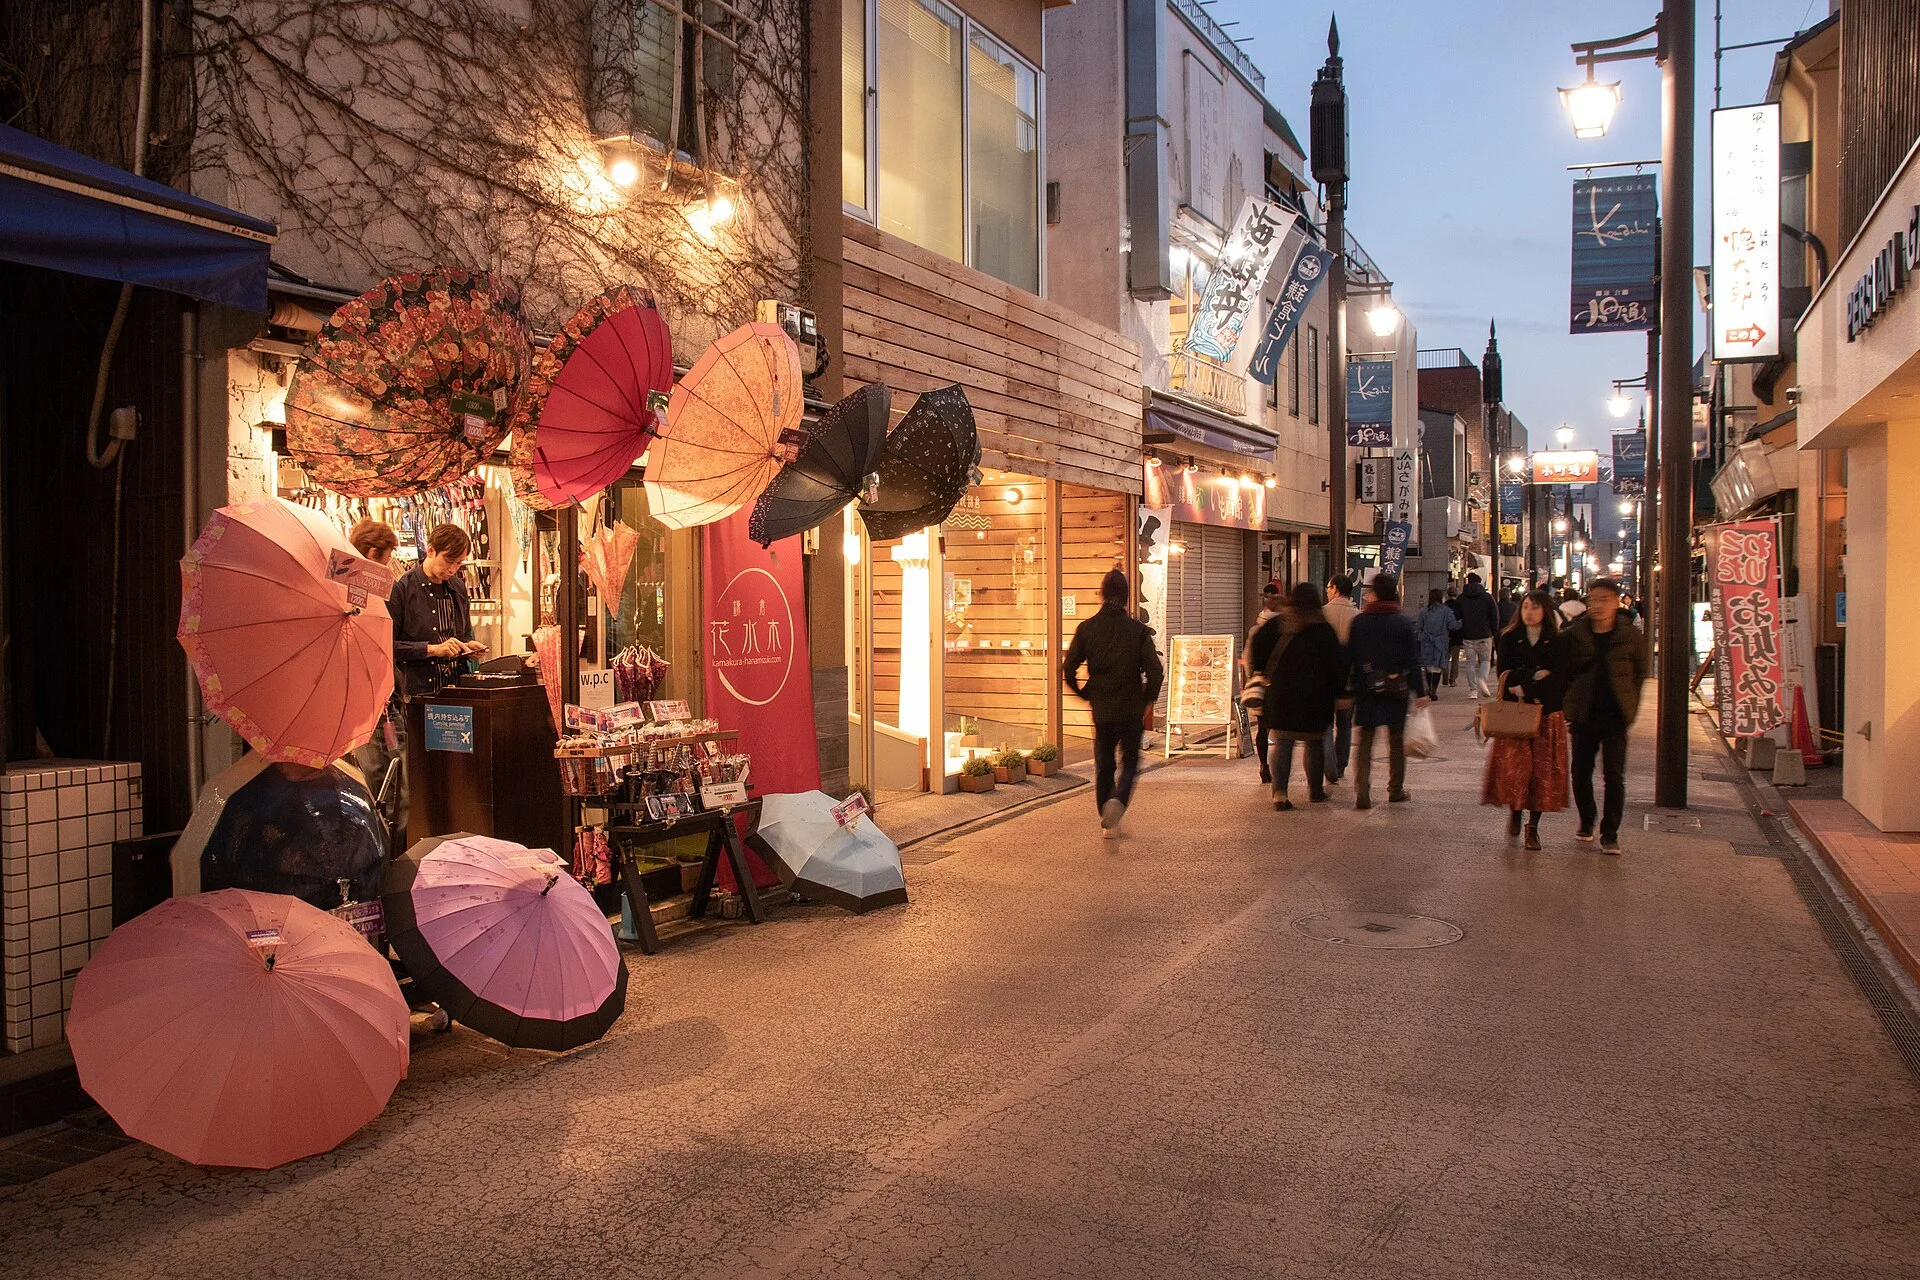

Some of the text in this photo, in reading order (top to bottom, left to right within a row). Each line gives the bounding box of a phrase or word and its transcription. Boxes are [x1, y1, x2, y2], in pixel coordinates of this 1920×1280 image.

[1576, 184, 1652, 194] KAMAKURA
[1847, 231, 1905, 343] PERSIAN
[710, 619, 782, 657] 花水木
[712, 656, 782, 667] kamakura-hanamizuki.com
[581, 672, 609, 691] w.p.c
